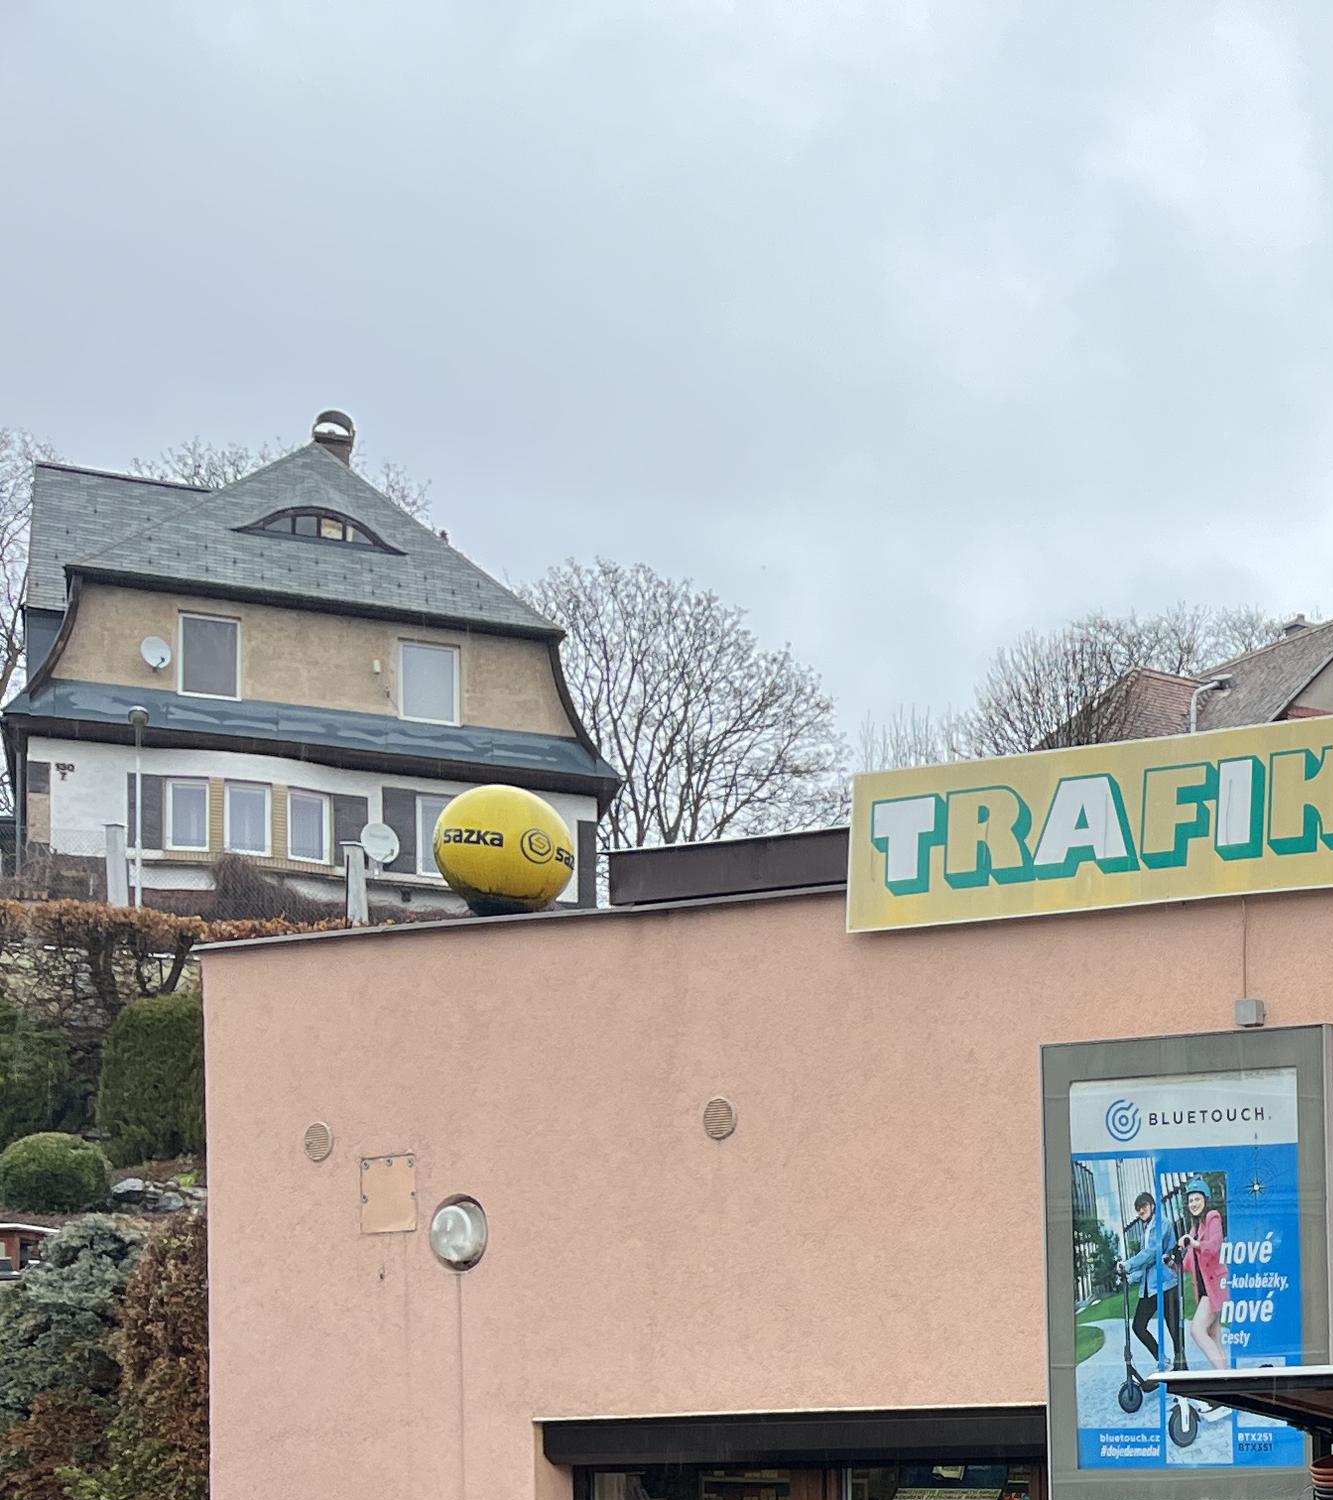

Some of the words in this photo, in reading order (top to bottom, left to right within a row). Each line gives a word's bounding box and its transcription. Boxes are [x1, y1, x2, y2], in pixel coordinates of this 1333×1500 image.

[1219, 1231, 1274, 1265] nové
[1220, 1290, 1275, 1324] nové
[1221, 1330, 1251, 1348] cesty
[1099, 1433, 1161, 1443] bluetouch.cz
